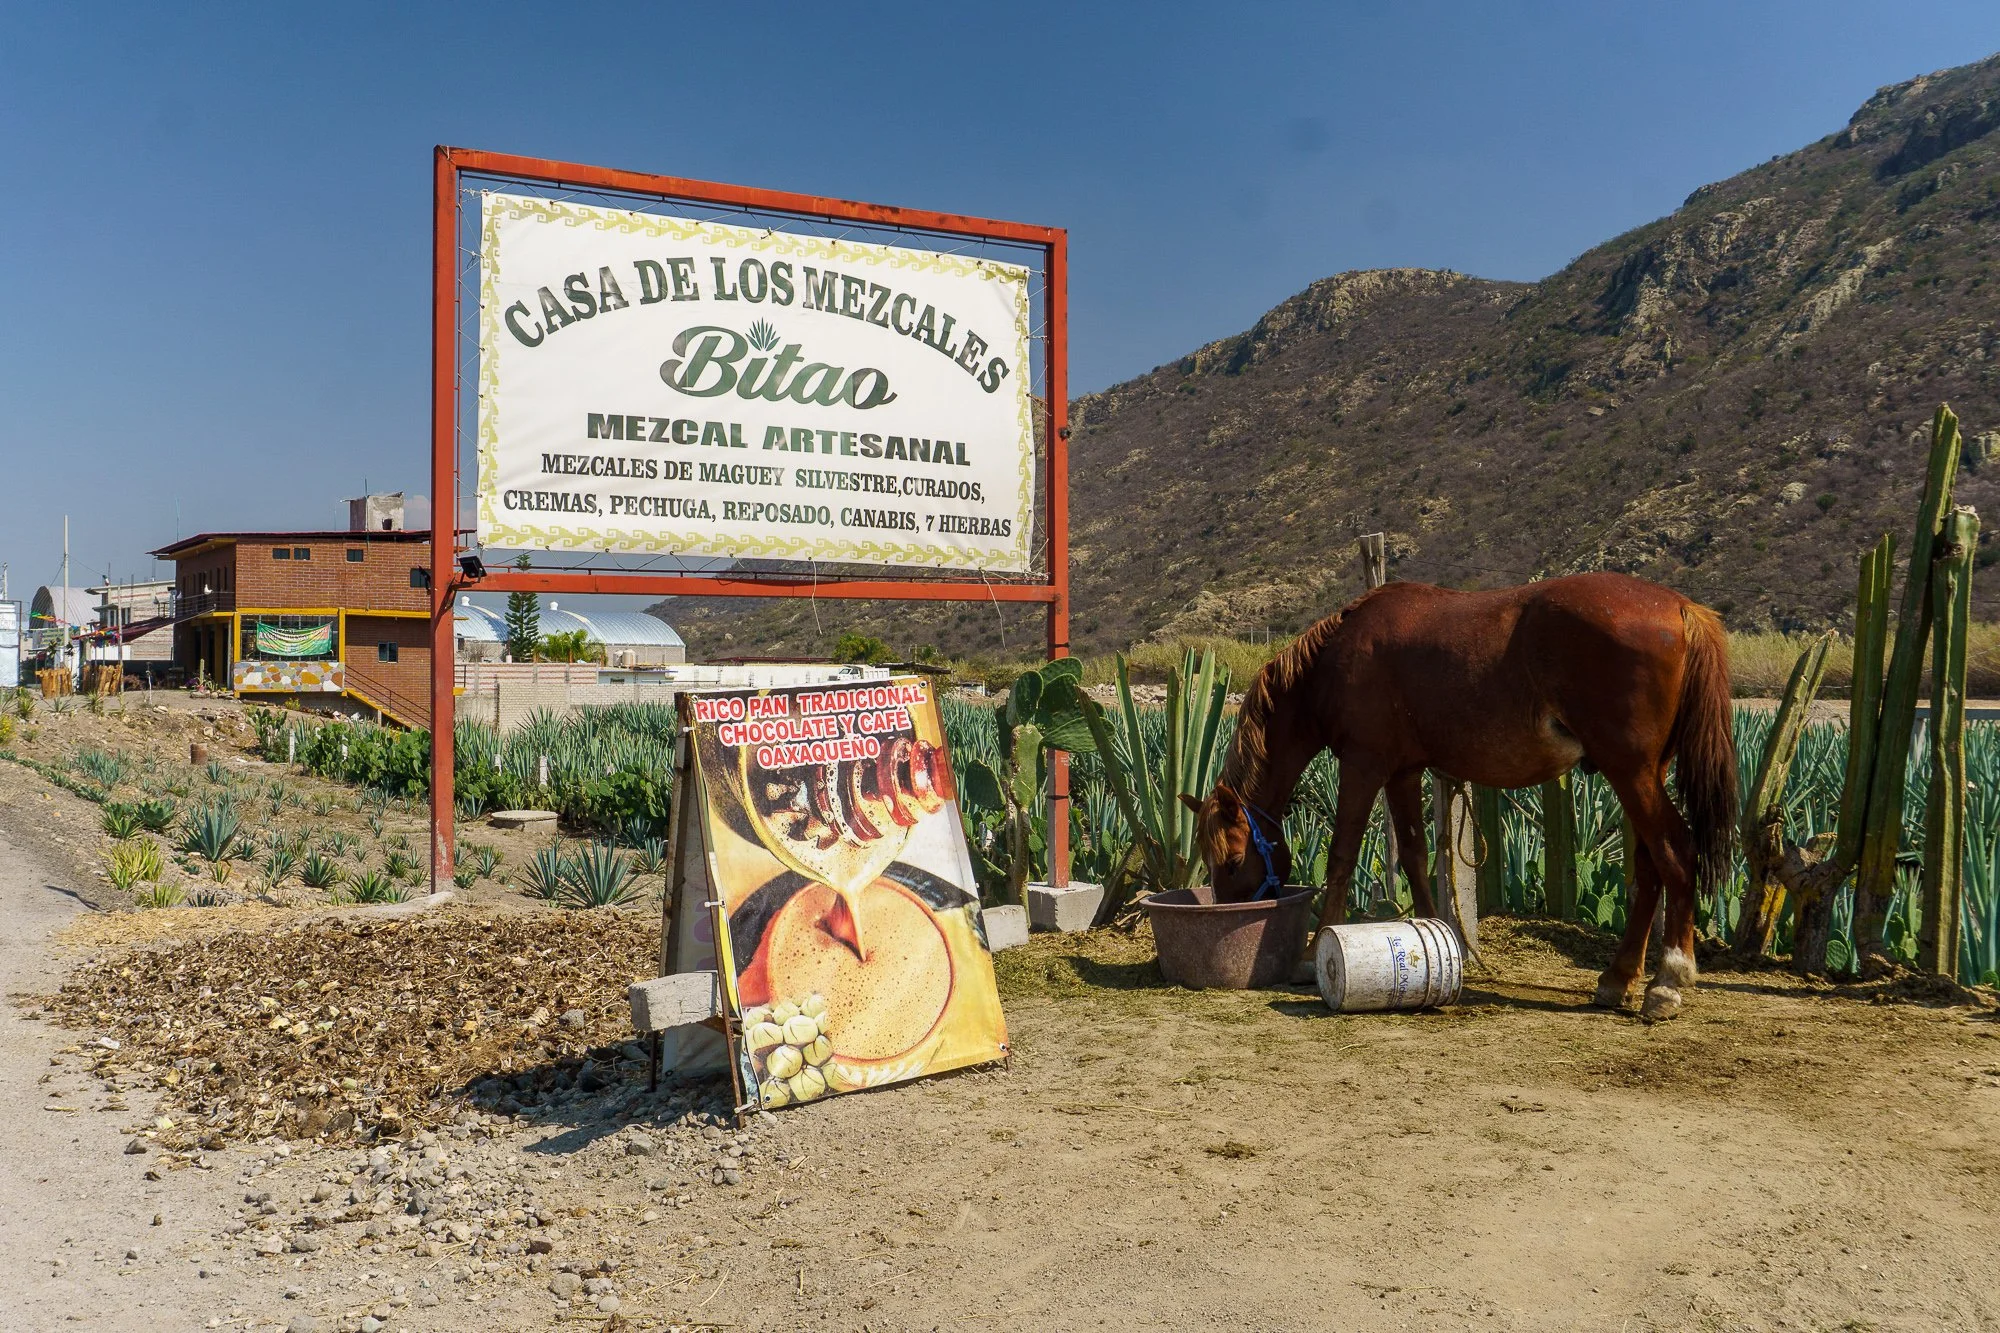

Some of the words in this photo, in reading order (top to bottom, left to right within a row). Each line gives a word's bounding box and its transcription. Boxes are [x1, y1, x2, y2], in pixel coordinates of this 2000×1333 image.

[504, 265, 630, 348] CASA
[633, 256, 700, 305] DE
[709, 256, 795, 306] LOS
[802, 265, 1011, 394] MEZCALES
[659, 324, 898, 410] Bitao
[587, 412, 749, 449] MEZCAL
[762, 425, 971, 467] ARTESANAL
[541, 453, 658, 480] MEZCALES
[663, 460, 693, 482] DE
[698, 462, 785, 487] MAGUEY
[503, 489, 603, 518] CREMAS,
[609, 494, 716, 523] PECHUGA,
[722, 500, 835, 529] REPOSADO,
[840, 507, 920, 534] CANABIS,
[925, 514, 934, 532] 7
[938, 514, 1012, 538] HIERBAS
[695, 698, 744, 721] RICO
[749, 695, 788, 718] PAN
[797, 686, 926, 715] TRADICIONAL
[720, 716, 836, 746] CHOCOLATE
[841, 713, 856, 734] Y
[858, 706, 911, 734] CAFÉ
[758, 735, 880, 768] OAXAQUEÑO
[1396, 948, 1409, 971] Real
